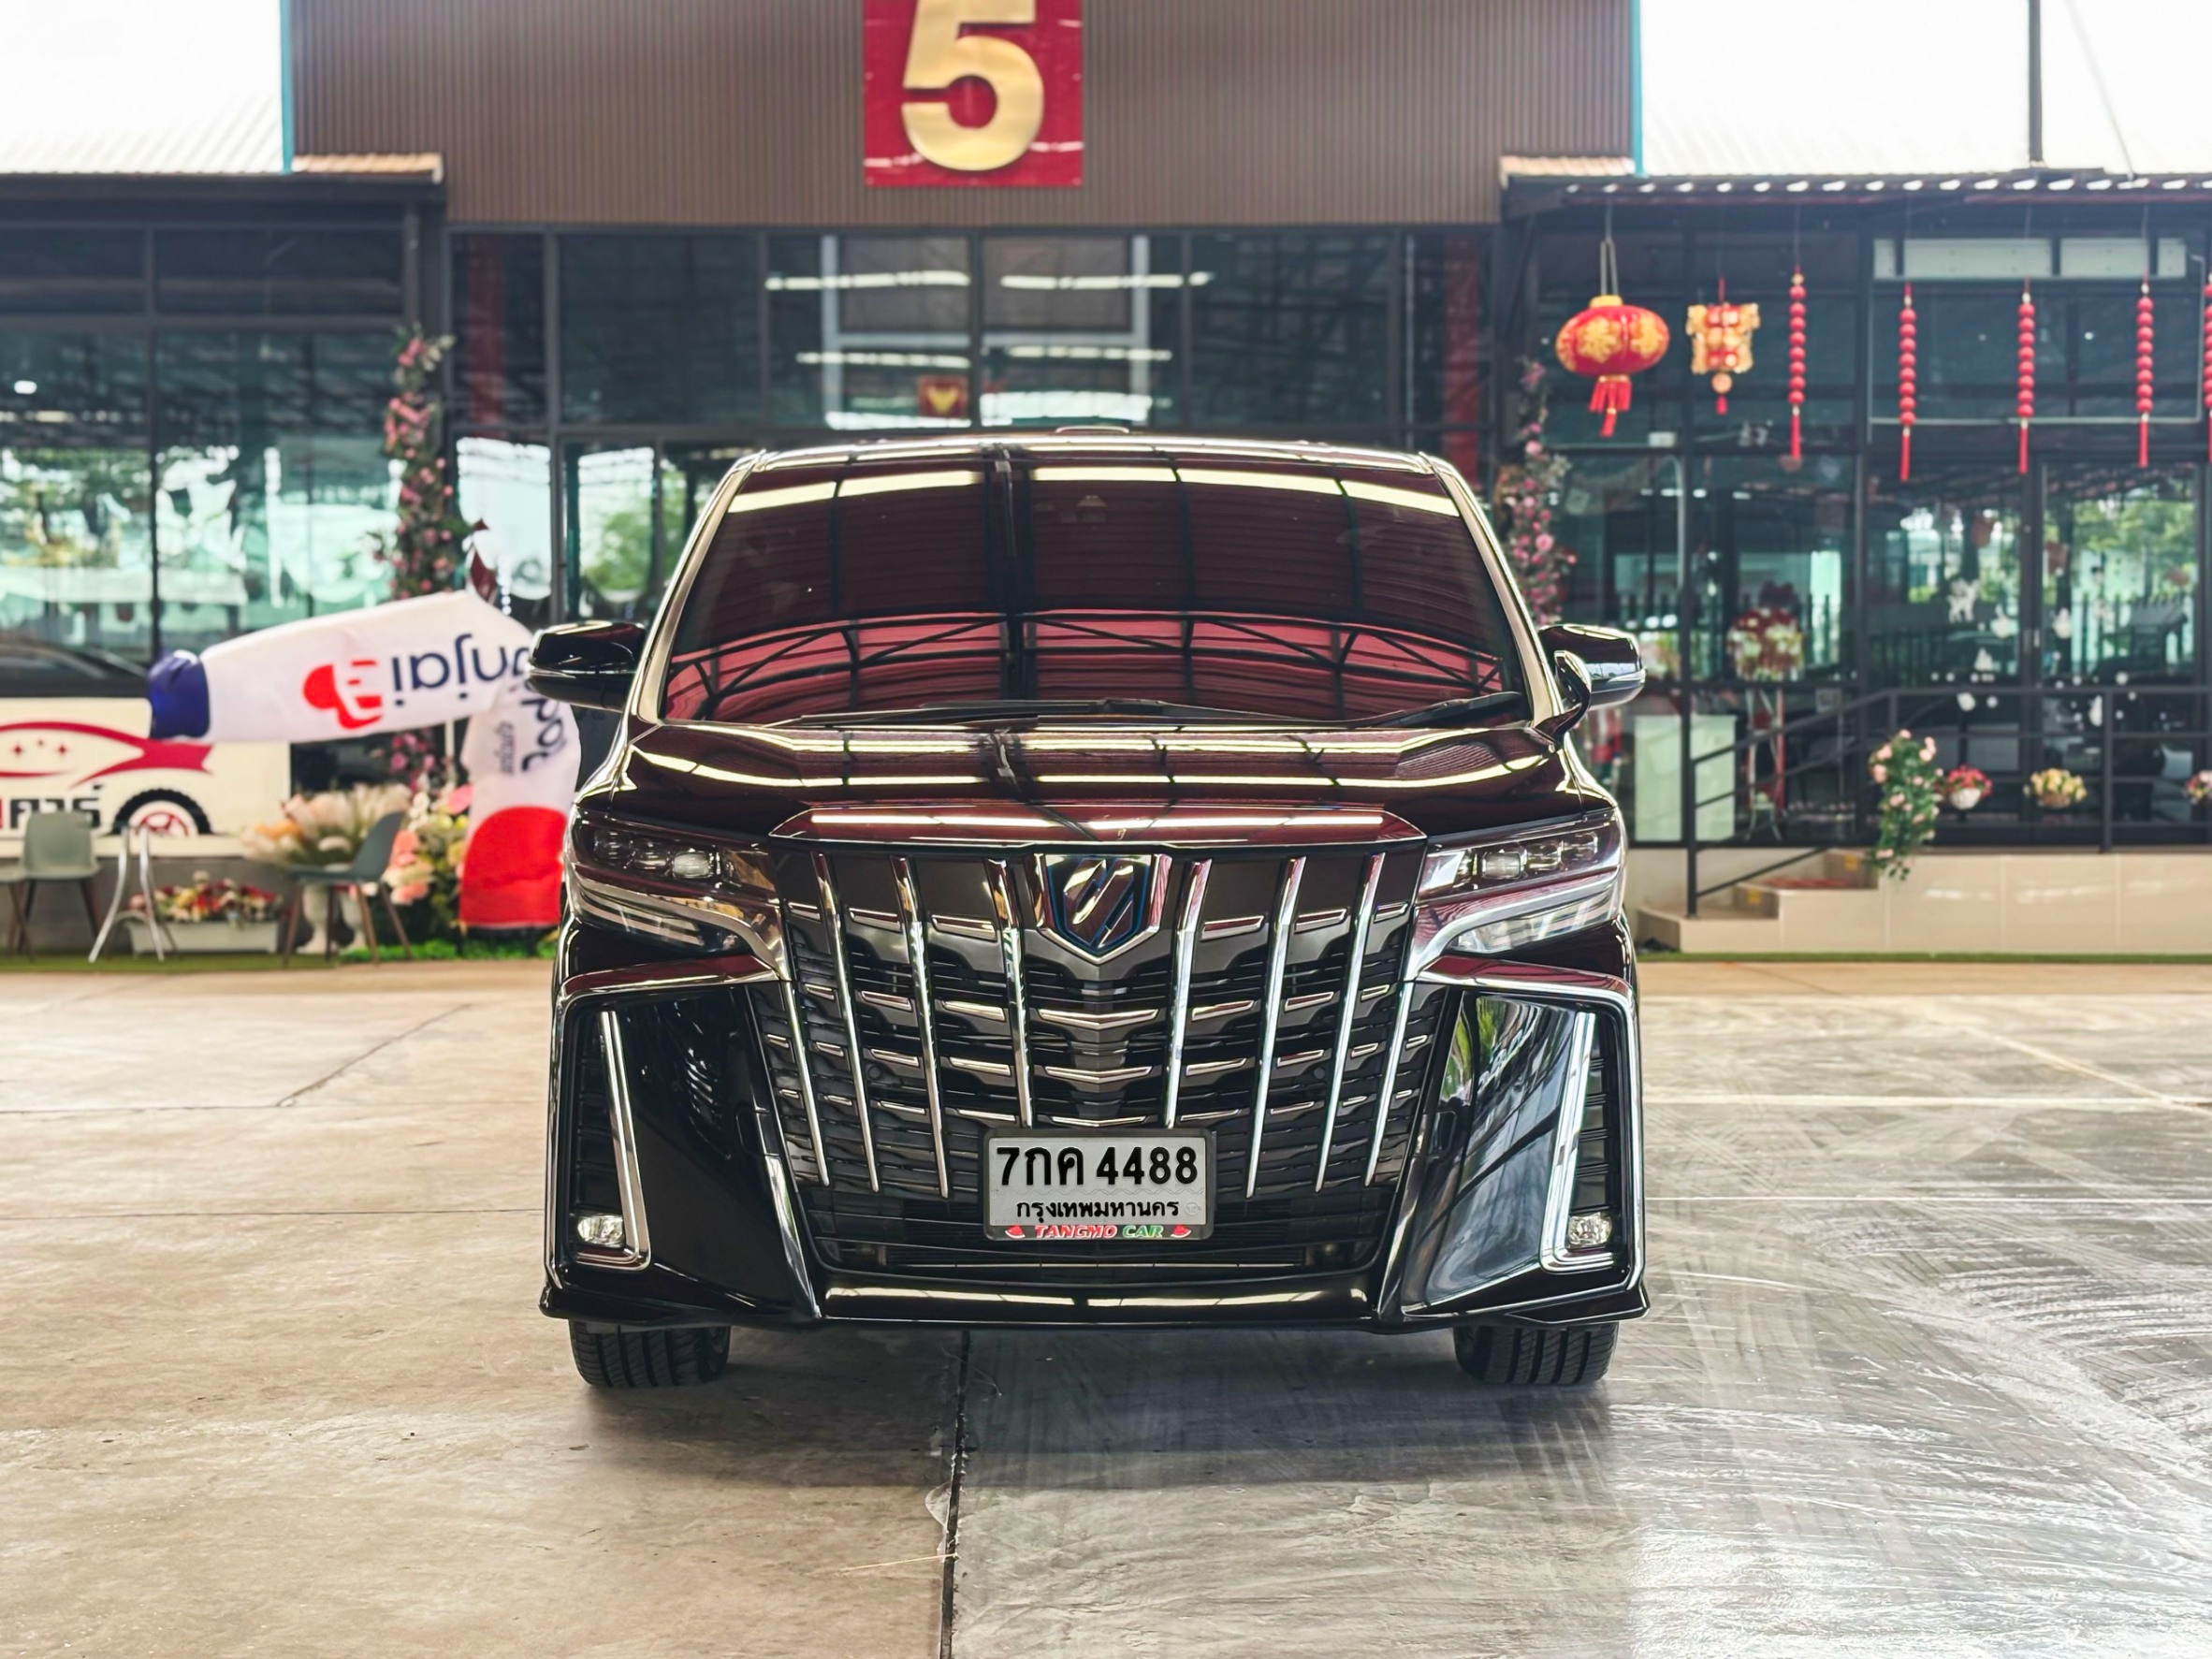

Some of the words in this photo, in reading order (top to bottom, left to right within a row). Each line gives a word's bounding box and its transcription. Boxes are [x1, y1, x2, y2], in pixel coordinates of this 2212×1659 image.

[901, 0, 1044, 171] 5
[997, 1146, 1084, 1186] 7กค
[1097, 1146, 1198, 1186] 4488
[1017, 1201, 1179, 1223] กรุงเทพมหานคร
[1035, 1225, 1117, 1239] TANGMO
[1123, 1225, 1163, 1239] CAR
